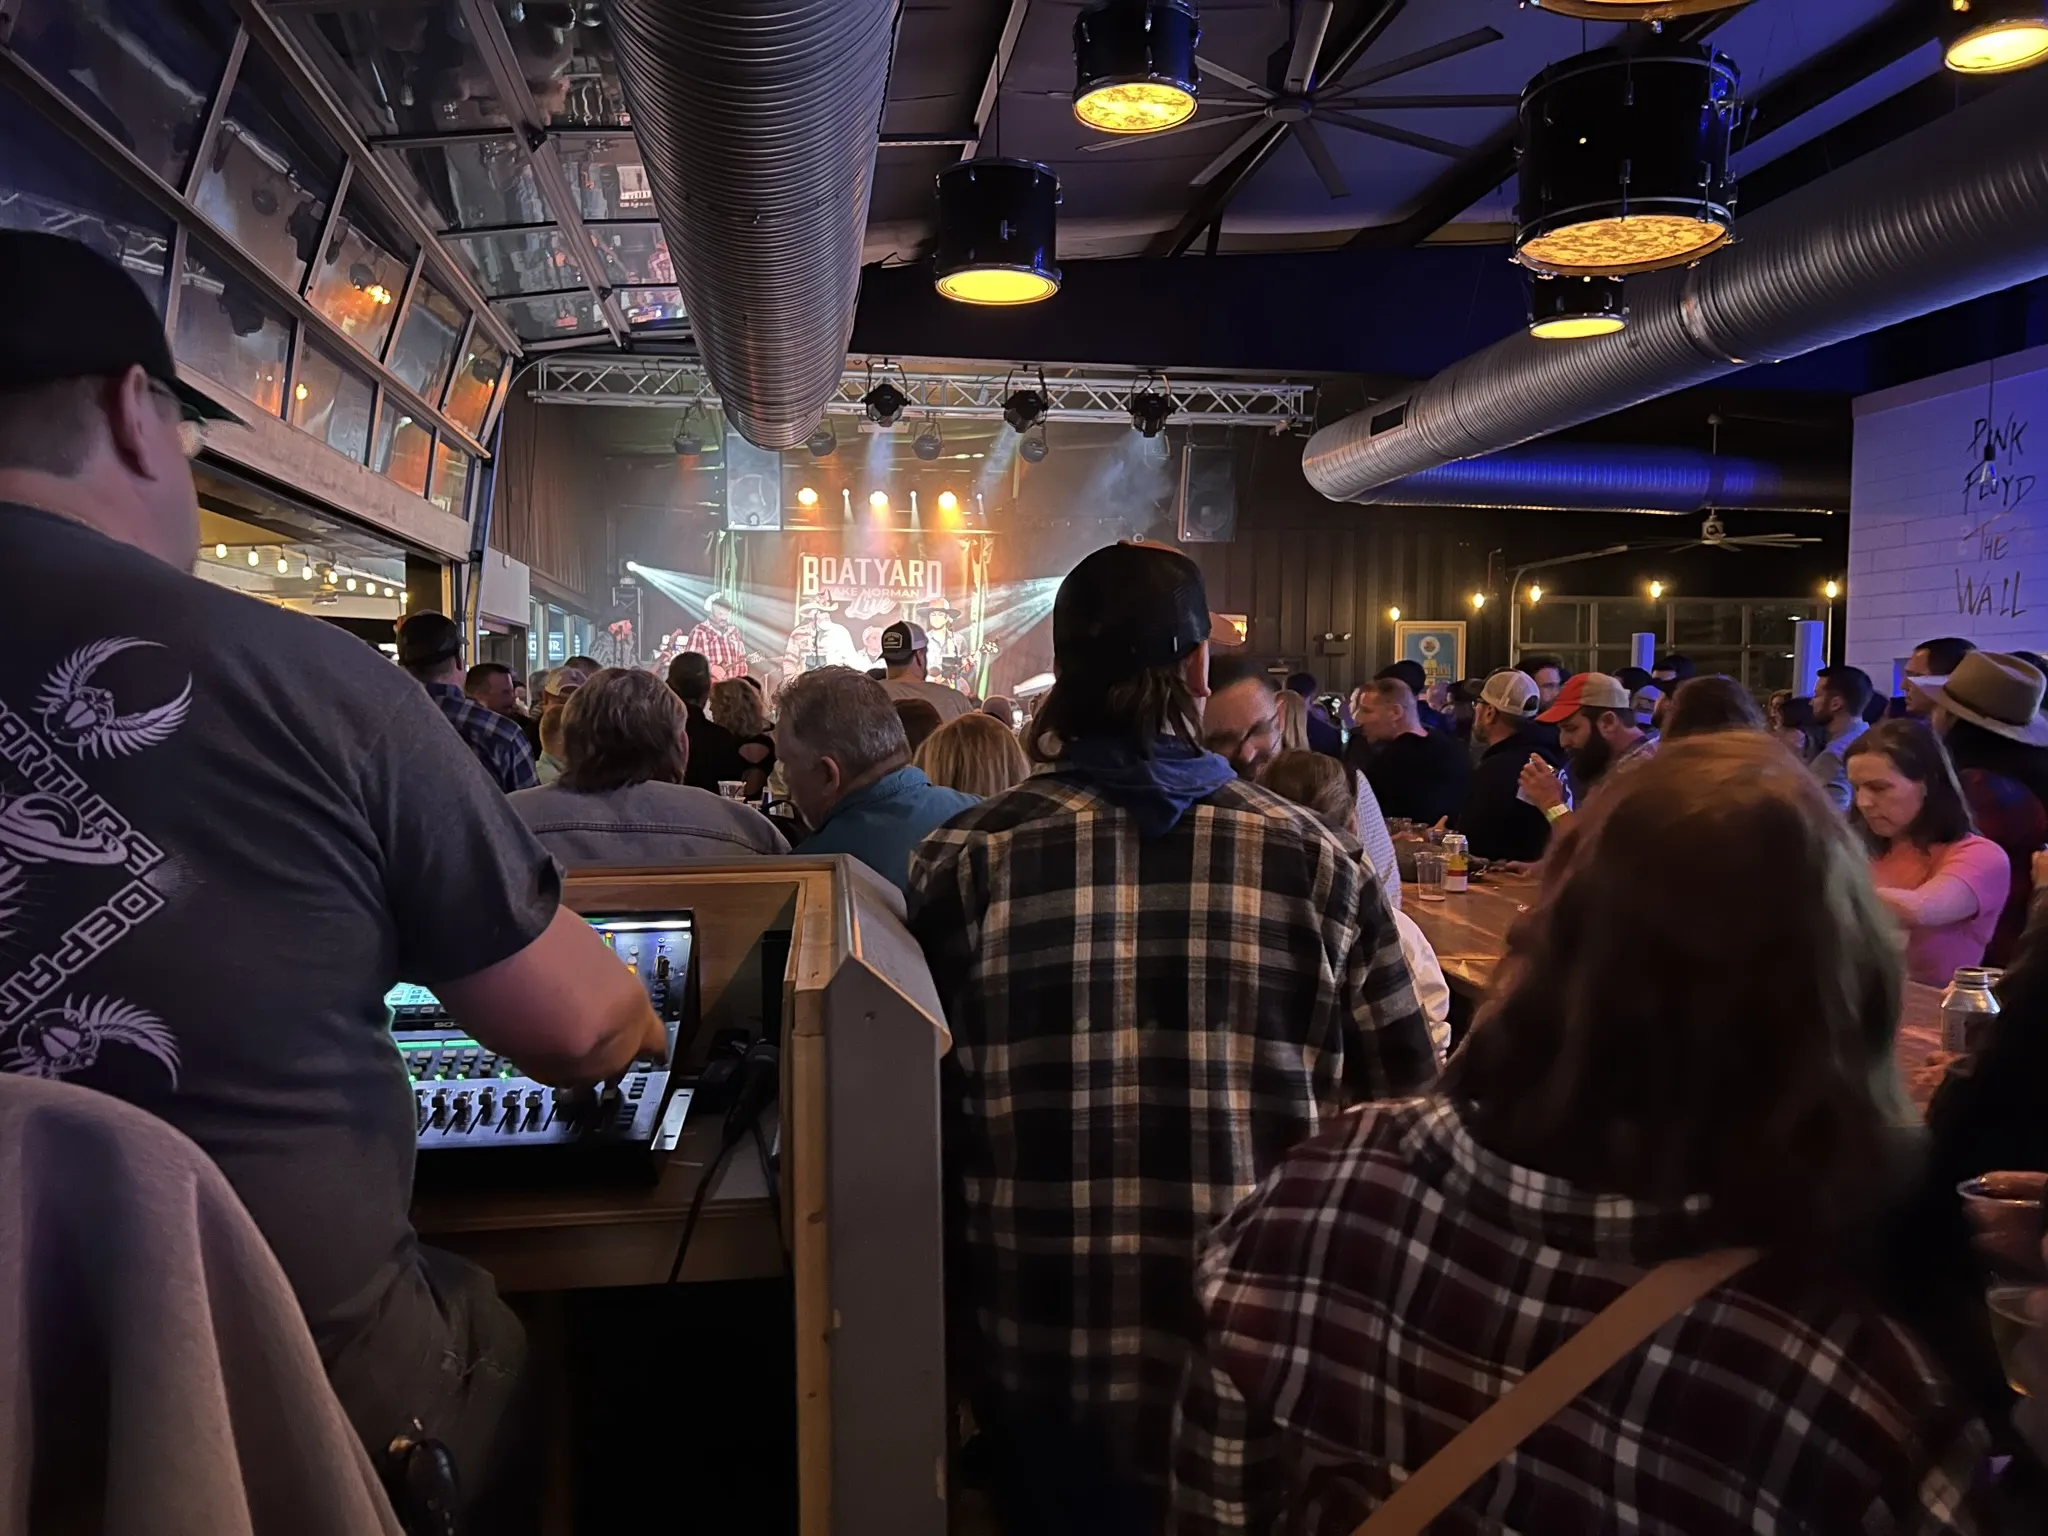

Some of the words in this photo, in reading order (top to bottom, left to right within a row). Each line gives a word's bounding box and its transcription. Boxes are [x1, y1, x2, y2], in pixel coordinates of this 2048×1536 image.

[1963, 515, 2016, 563] THE
[802, 555, 942, 598] BOATYARD
[862, 587, 920, 598] NORMAN
[1954, 568, 2027, 618] WALL
[0, 880, 165, 1034] DEPAR
